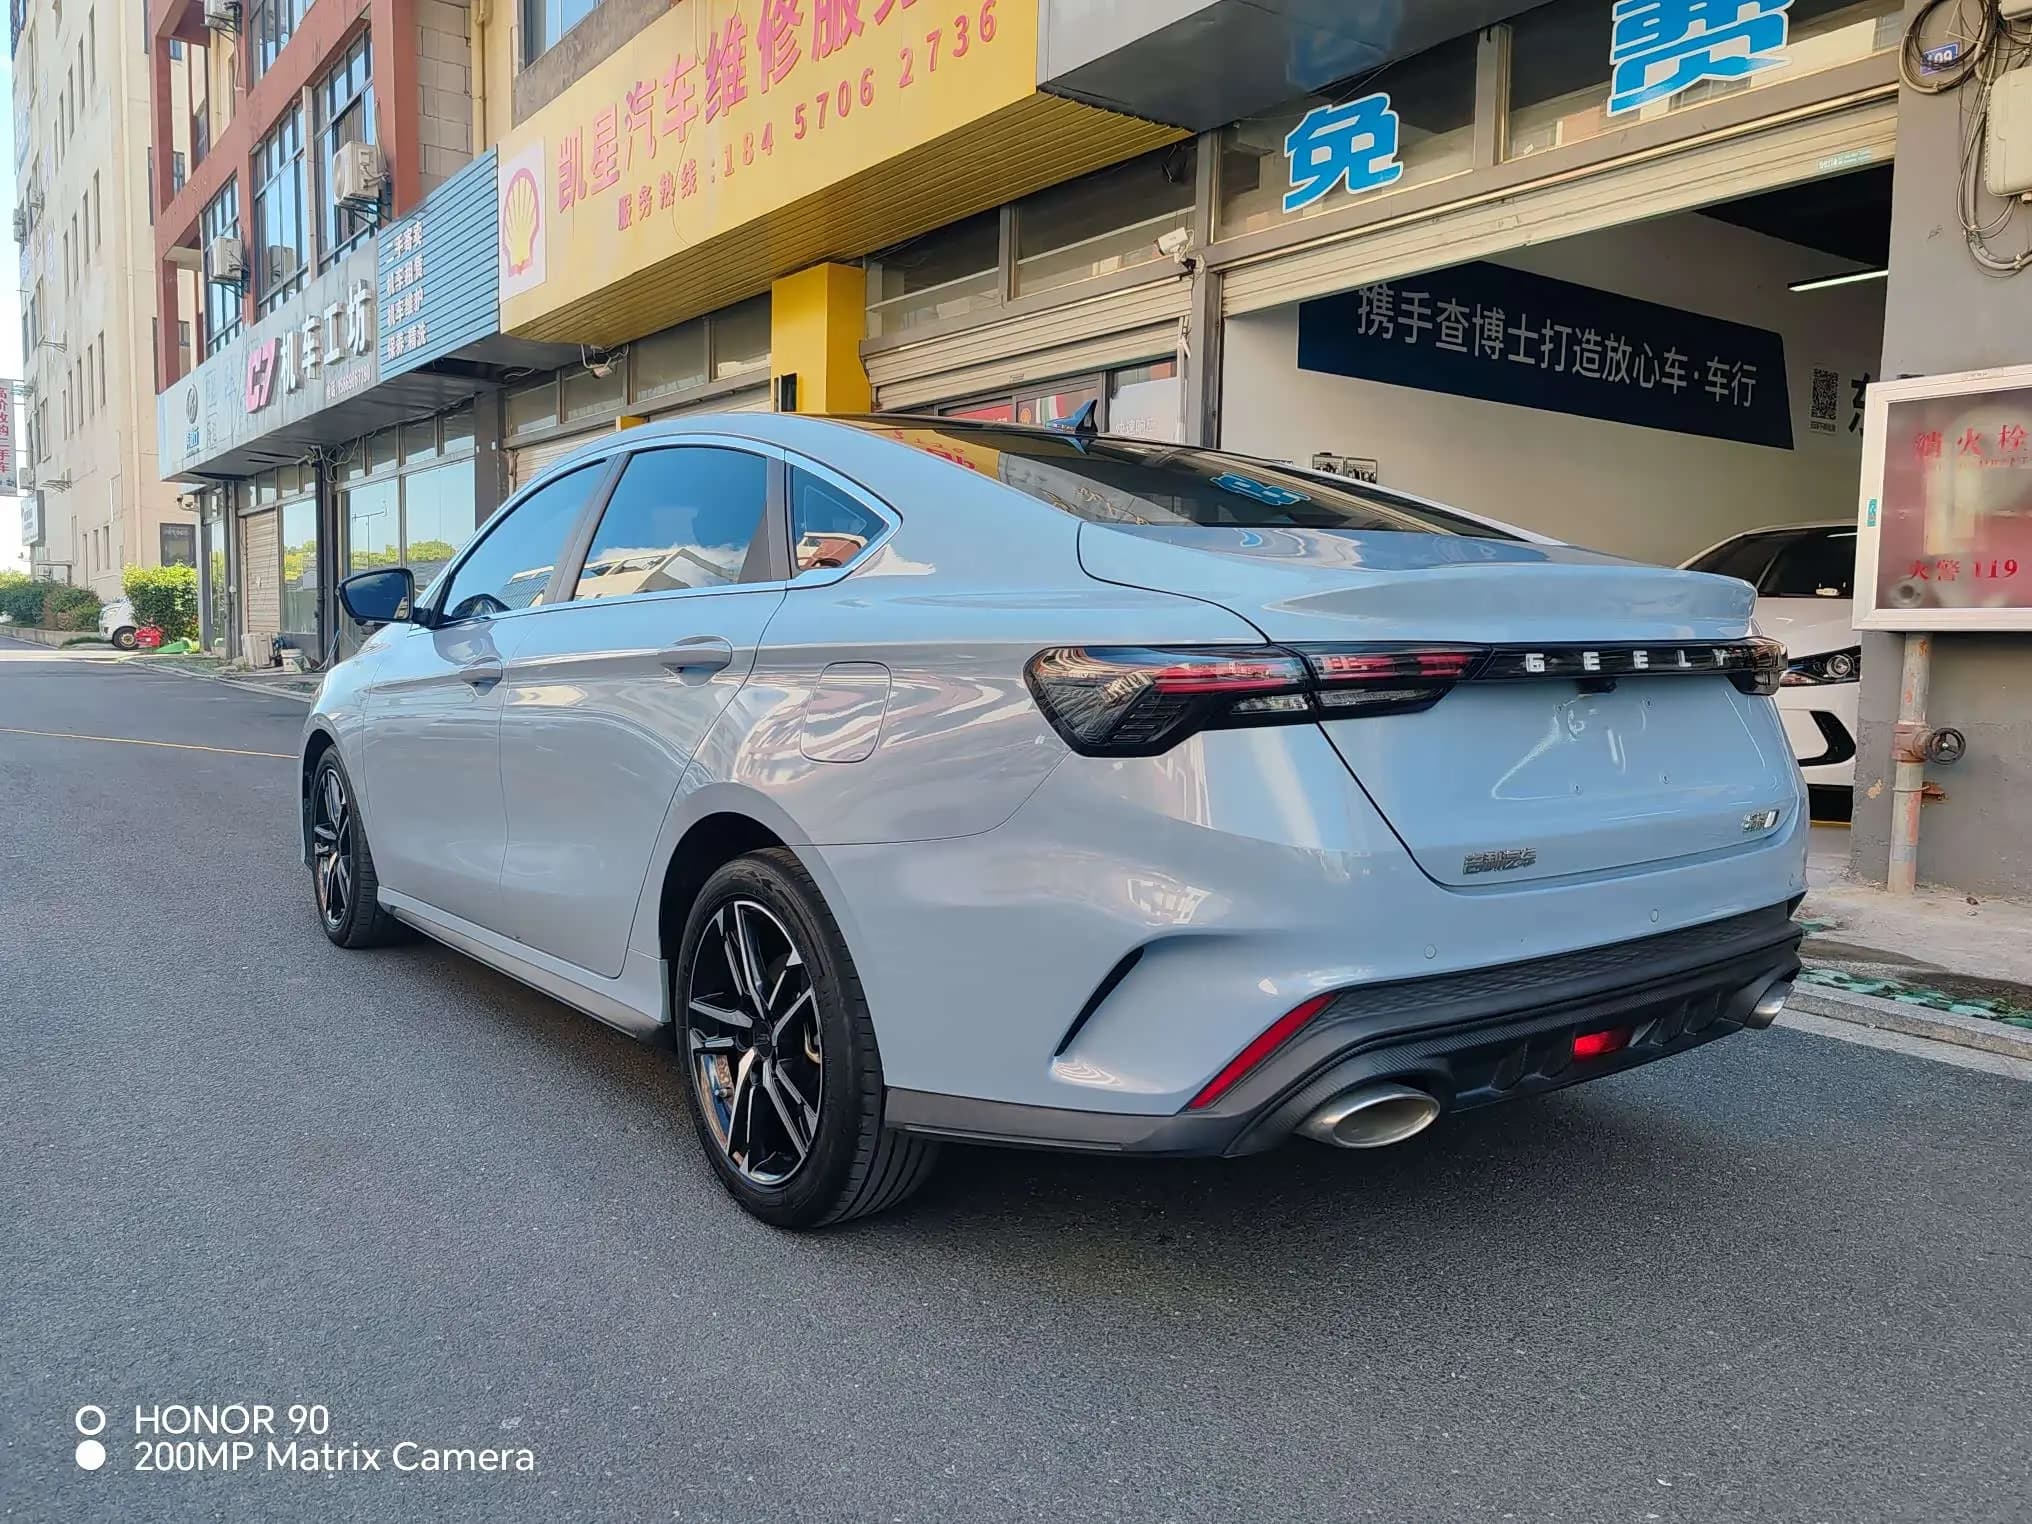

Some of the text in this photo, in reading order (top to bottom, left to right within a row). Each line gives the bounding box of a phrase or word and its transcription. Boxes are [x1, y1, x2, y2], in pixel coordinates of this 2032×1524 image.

[558, 0, 918, 213] 凯星汽车维修服
[793, 67, 874, 140] 5706
[898, 0, 998, 89] 2736
[1282, 91, 1403, 214] 免
[280, 278, 372, 394] 机车工坊
[387, 287, 424, 328] 机车维护
[1356, 282, 1757, 408] 携手查博士打造放心车·车行
[1914, 423, 2028, 460] 消火栓
[1975, 559, 2018, 579] 119
[1525, 649, 1729, 674] GEELY
